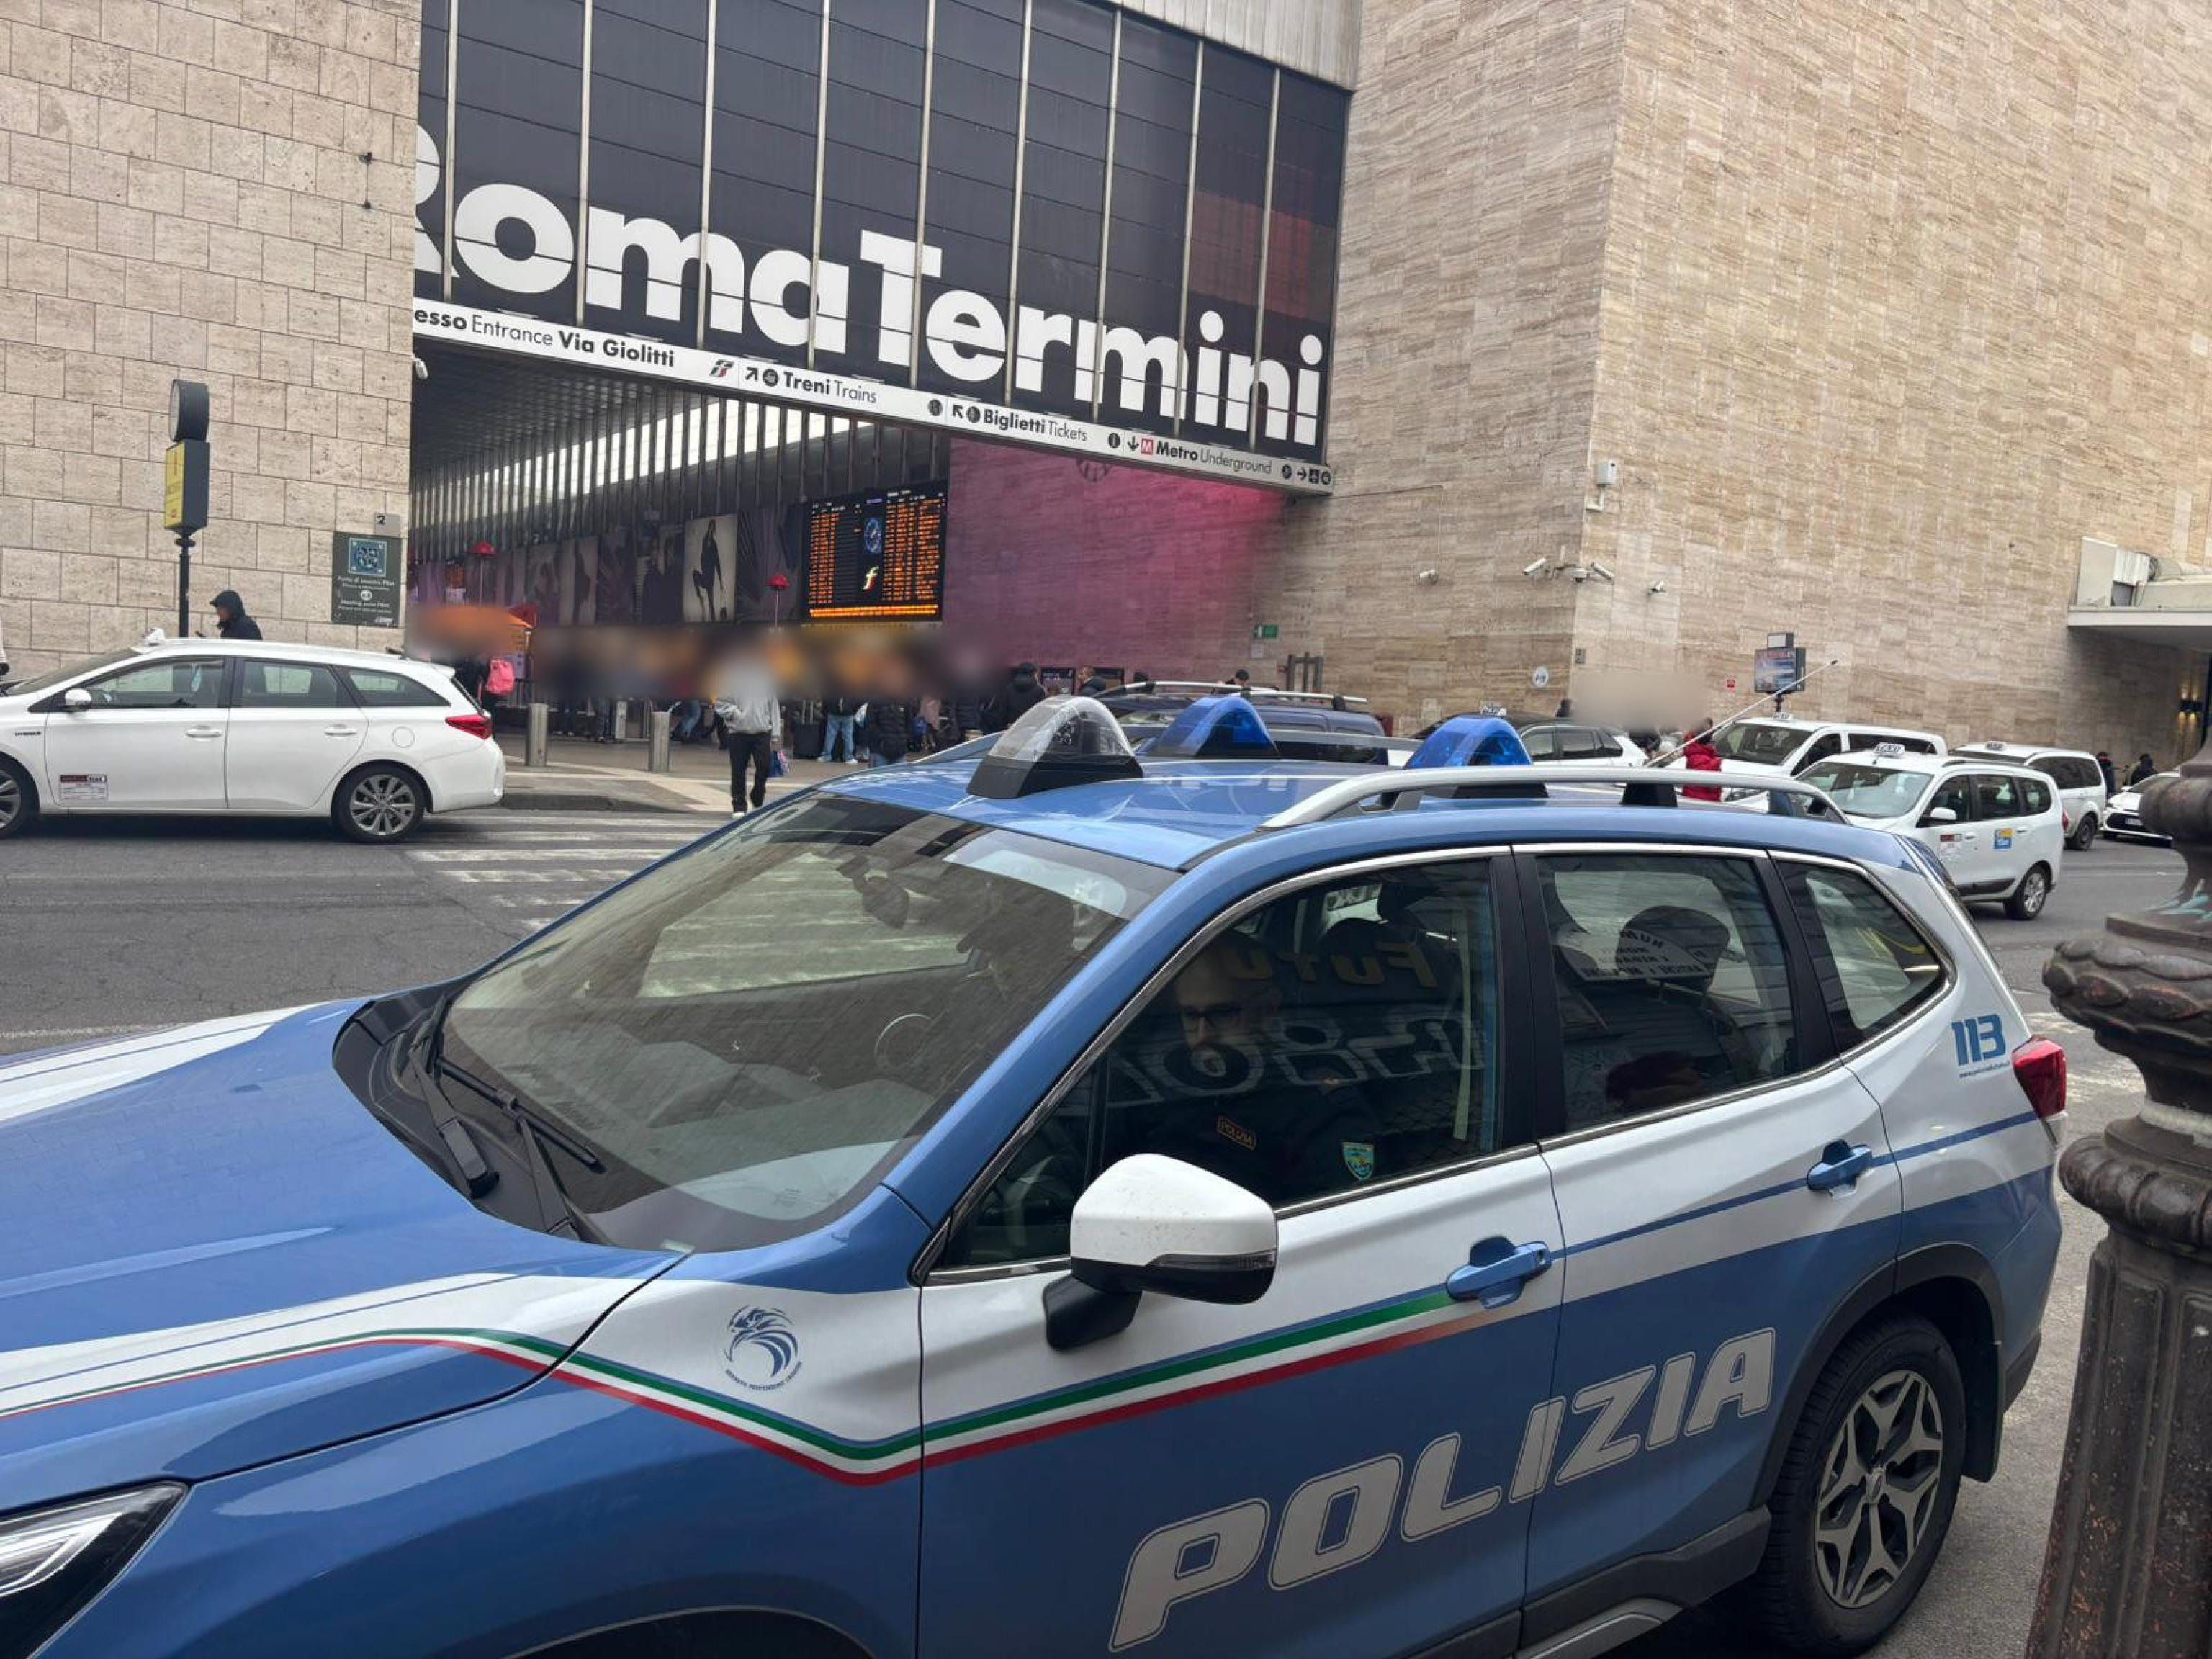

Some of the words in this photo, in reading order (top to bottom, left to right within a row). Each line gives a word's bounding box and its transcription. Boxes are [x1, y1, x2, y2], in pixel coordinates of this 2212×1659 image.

[472, 315, 553, 346] Entrance
[559, 330, 595, 354] Via
[603, 339, 674, 367] Giolitti
[784, 372, 830, 395] Treni
[834, 382, 877, 404] Trains
[984, 408, 1045, 437] Biglietti
[1048, 421, 1087, 441] Tickets
[1156, 441, 1198, 461] Metro
[1200, 451, 1272, 474] Underground
[1951, 1014, 2005, 1066] 113
[1109, 1328, 1775, 1652] POLIZIA
